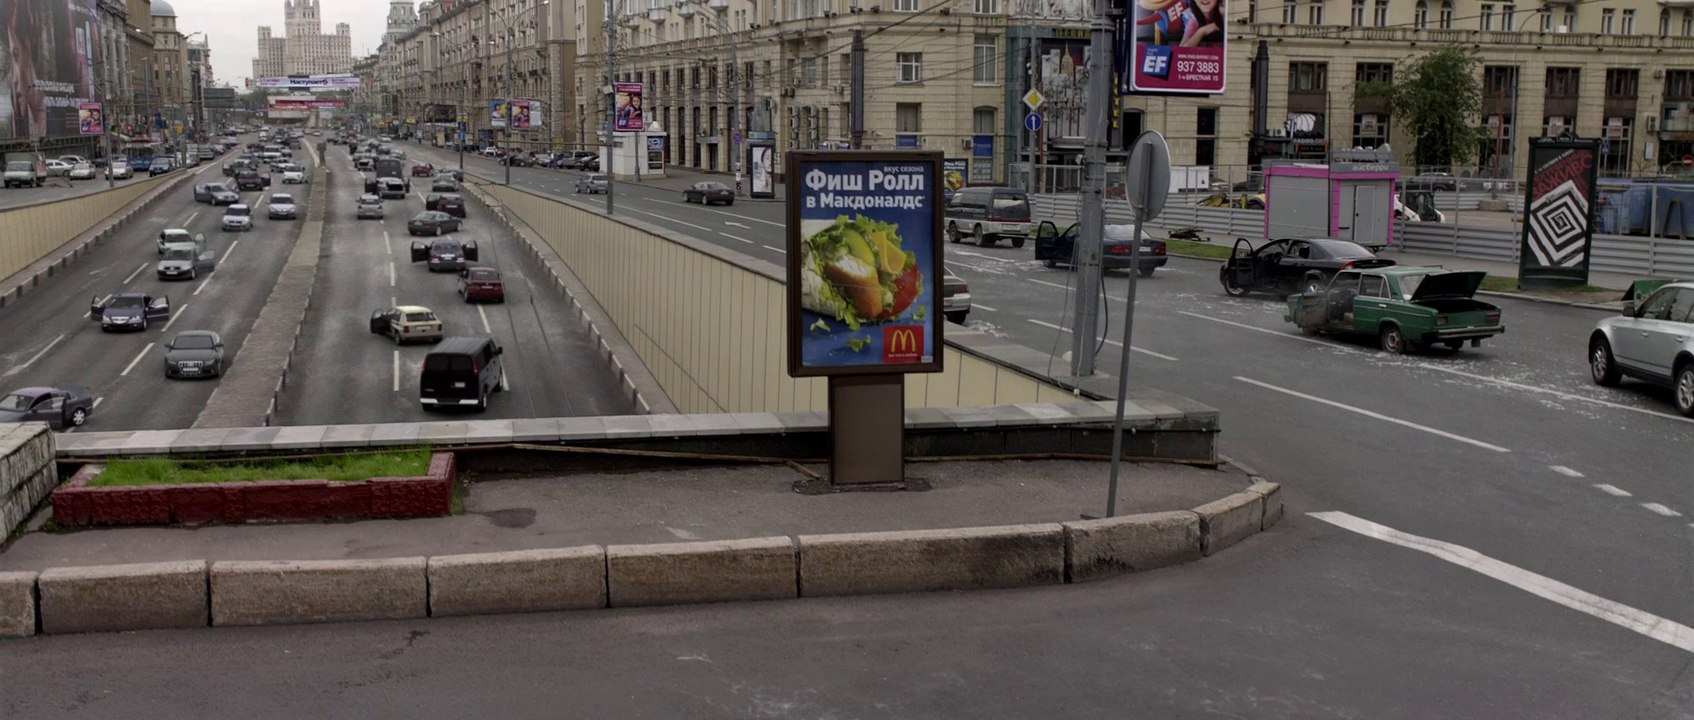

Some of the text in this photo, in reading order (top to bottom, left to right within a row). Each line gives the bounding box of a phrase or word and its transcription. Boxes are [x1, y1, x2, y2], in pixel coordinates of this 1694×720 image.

[1143, 55, 1167, 73] EF
[1177, 61, 1219, 73] 937 3883
[884, 166, 900, 174] вкус
[805, 168, 924, 191] Фиш Ролл
[806, 192, 923, 210] в Макдоналдс
